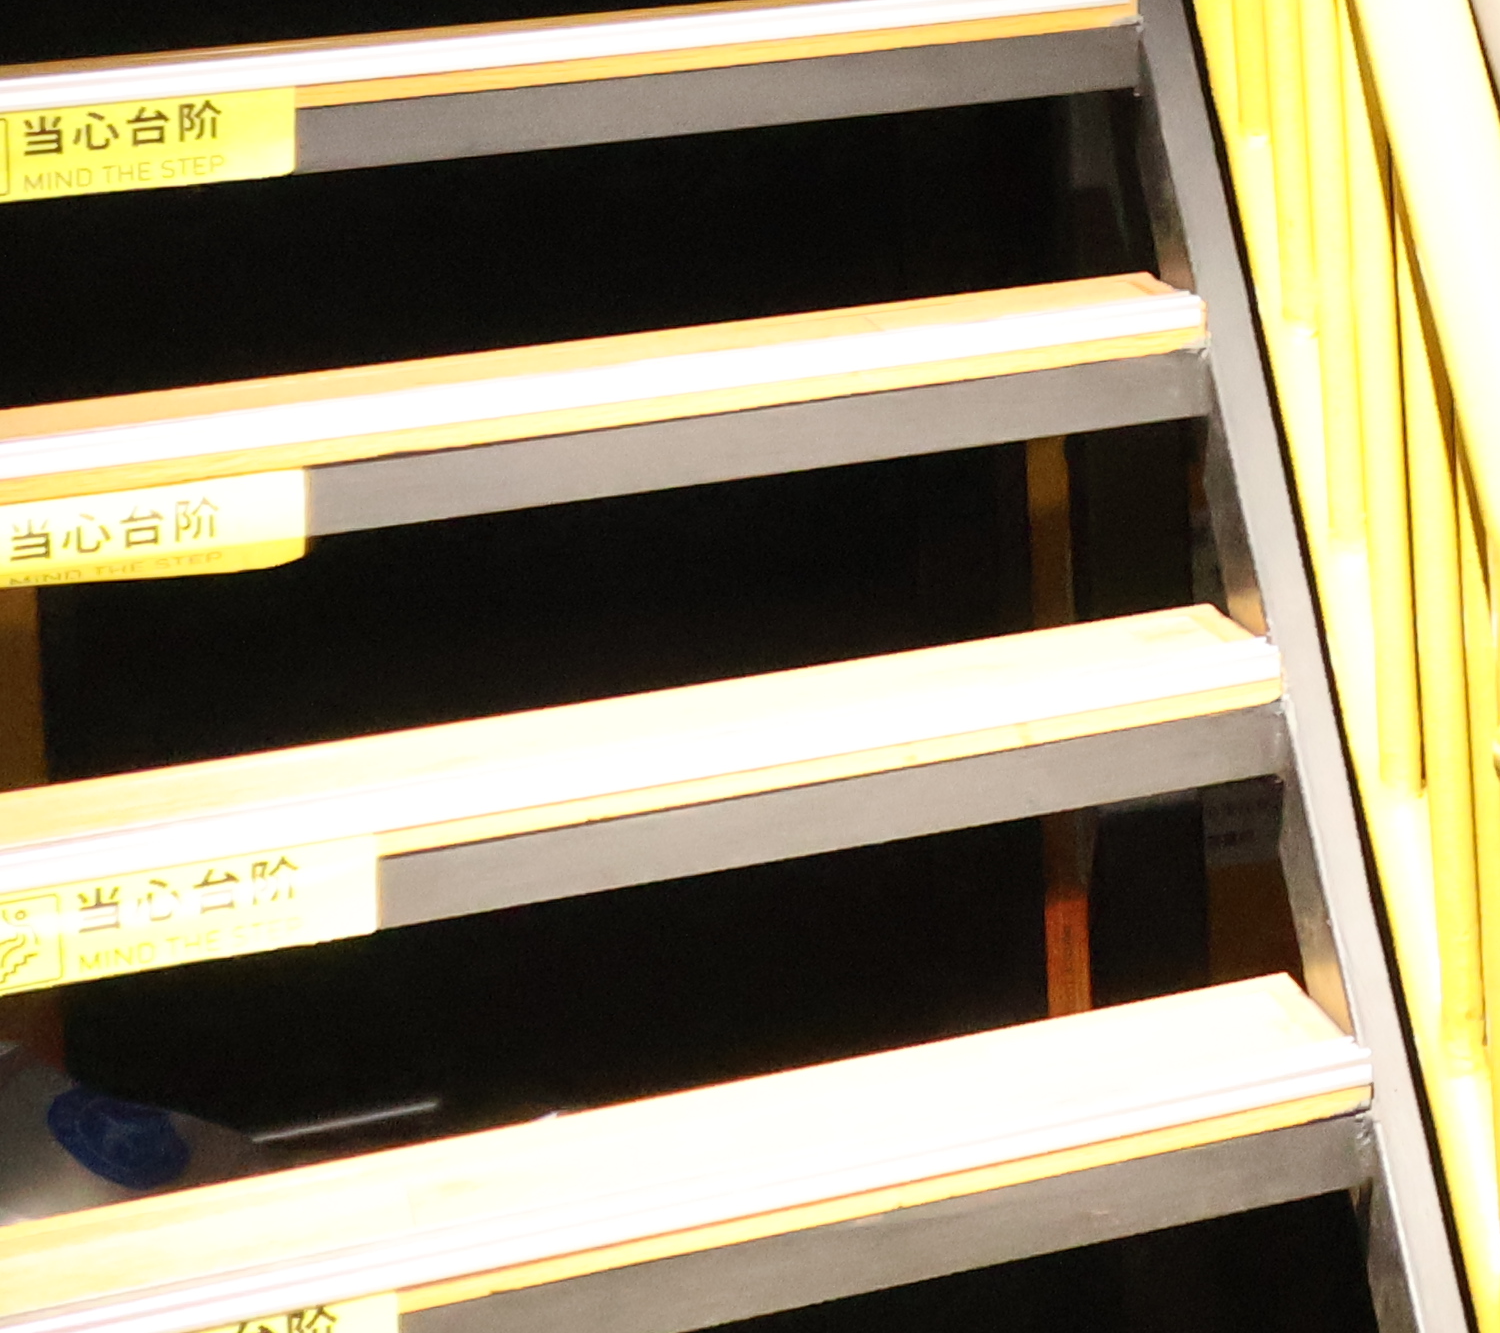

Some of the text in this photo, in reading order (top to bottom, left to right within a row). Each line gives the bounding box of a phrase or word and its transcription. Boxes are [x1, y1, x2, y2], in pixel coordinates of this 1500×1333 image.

[23, 100, 222, 157] 当心台阶
[23, 154, 225, 192] MIND THE STEP
[10, 496, 219, 562] 当心台阶
[78, 856, 299, 934] 当心台阶
[78, 941, 156, 973] MIND
[165, 930, 222, 957] THE
